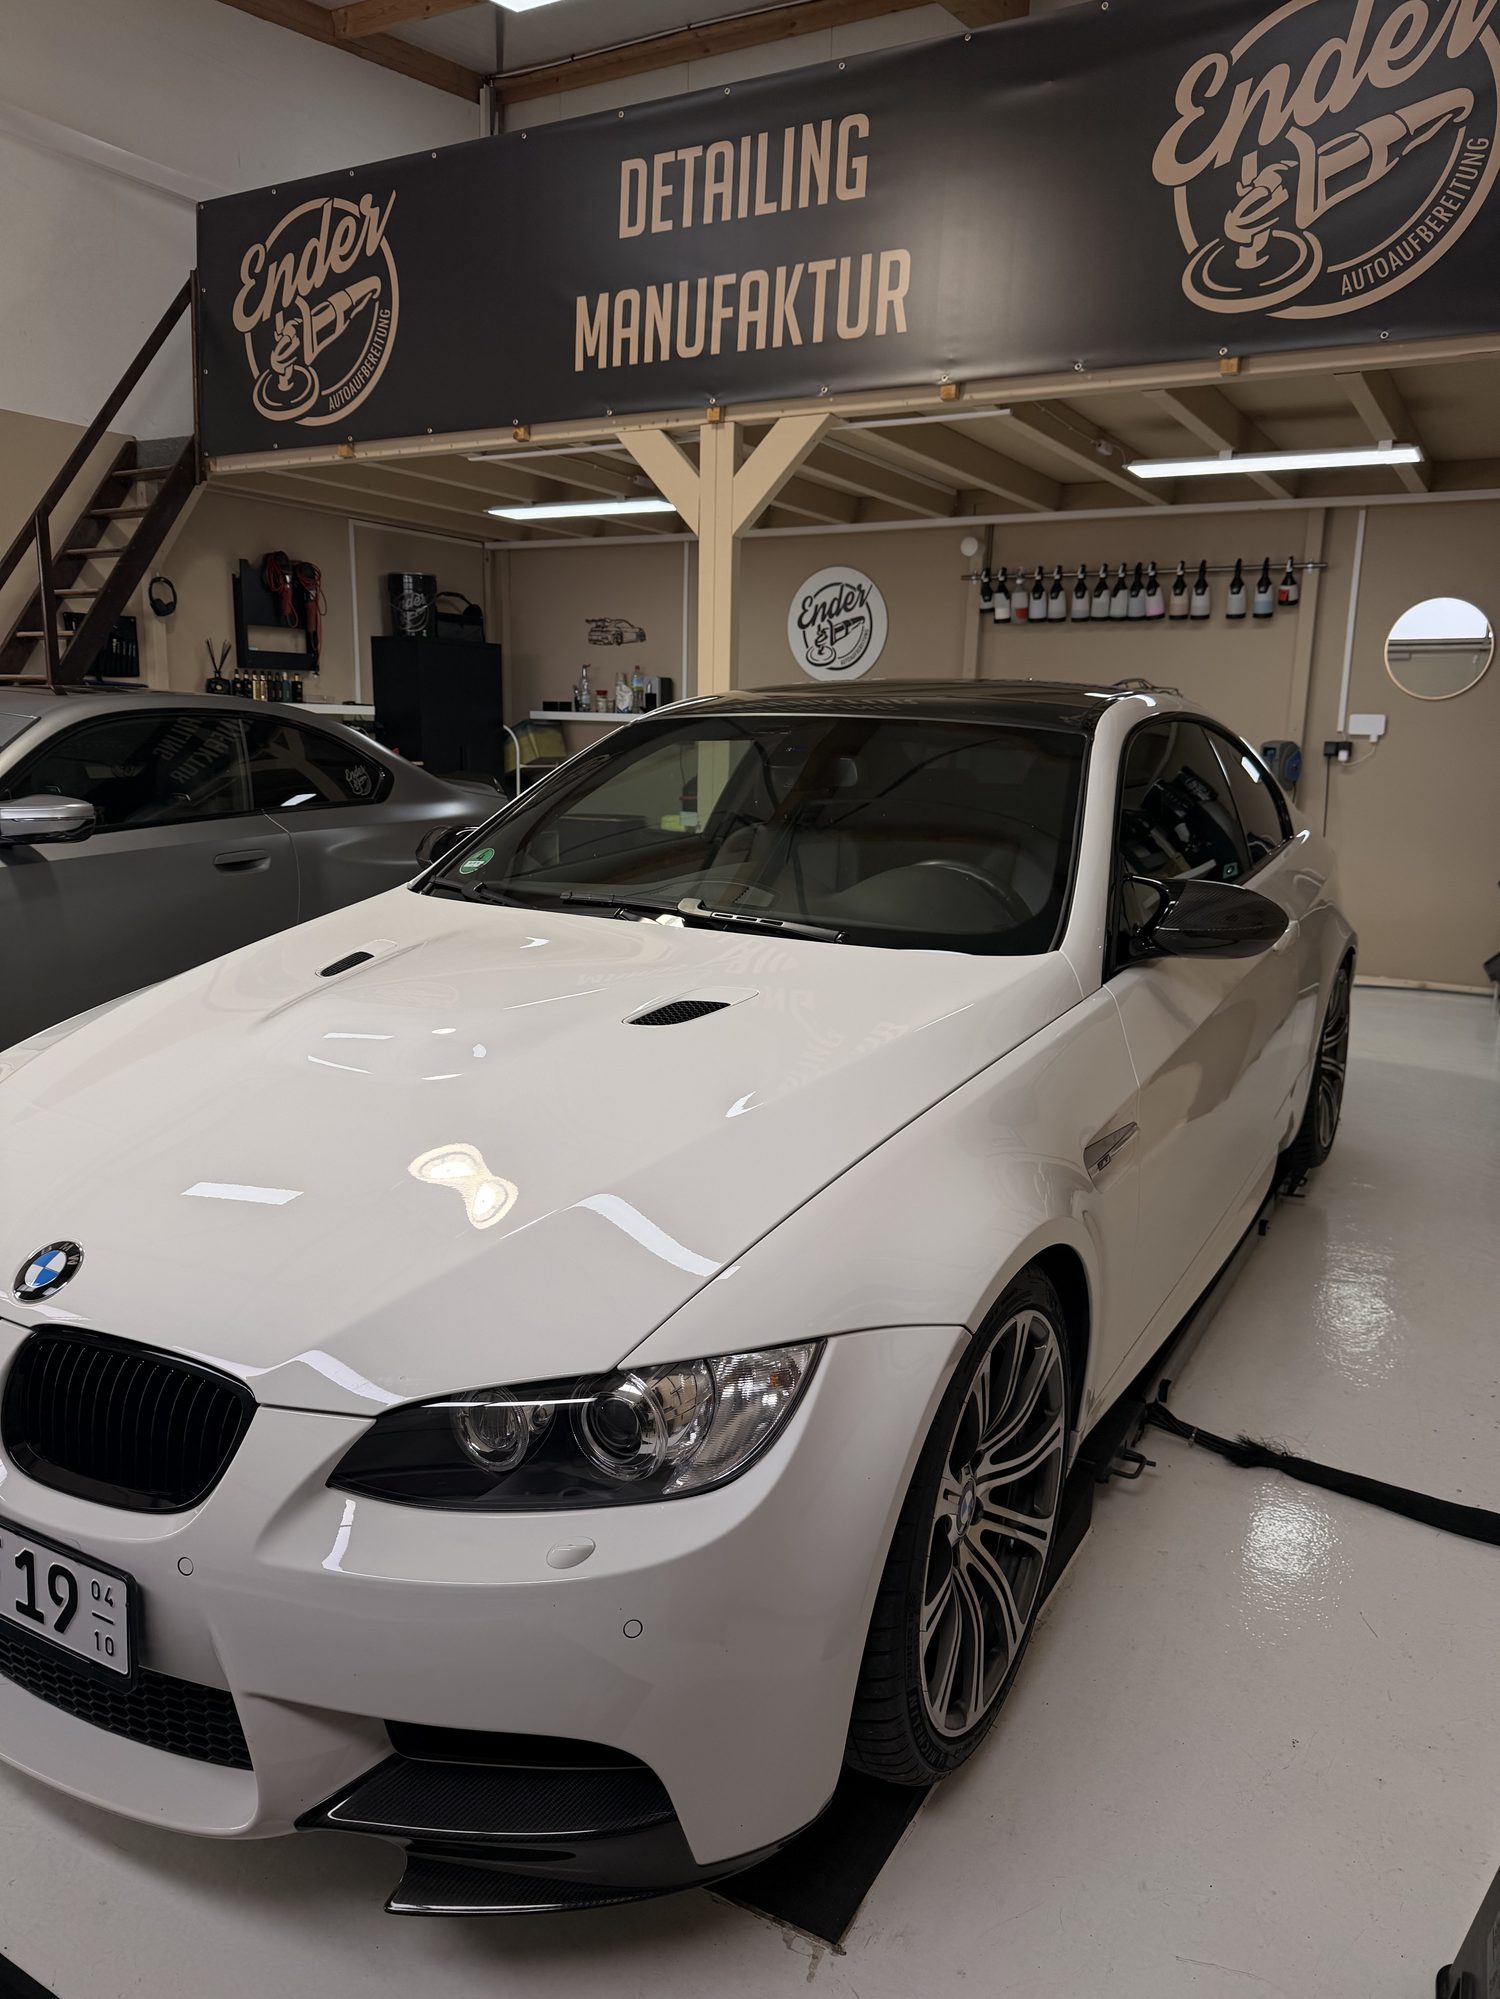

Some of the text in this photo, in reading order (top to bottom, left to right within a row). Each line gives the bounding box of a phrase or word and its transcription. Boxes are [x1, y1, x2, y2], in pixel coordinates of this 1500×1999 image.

[1152, 0, 1499, 187] Ender
[619, 113, 870, 239] DETAILING
[1341, 136, 1489, 295] AUTOAUFBEREITUNG
[232, 189, 397, 333] Ender
[574, 249, 911, 372] MANUFAKTUR
[328, 308, 391, 411] AUTOAUFBEREITUNG
[797, 584, 873, 630] Ender
[15, 1548, 78, 1634] 19
[91, 1579, 114, 1608] 04
[94, 1630, 114, 1657] 10
[908, 1693, 940, 1763] MICHELIN
